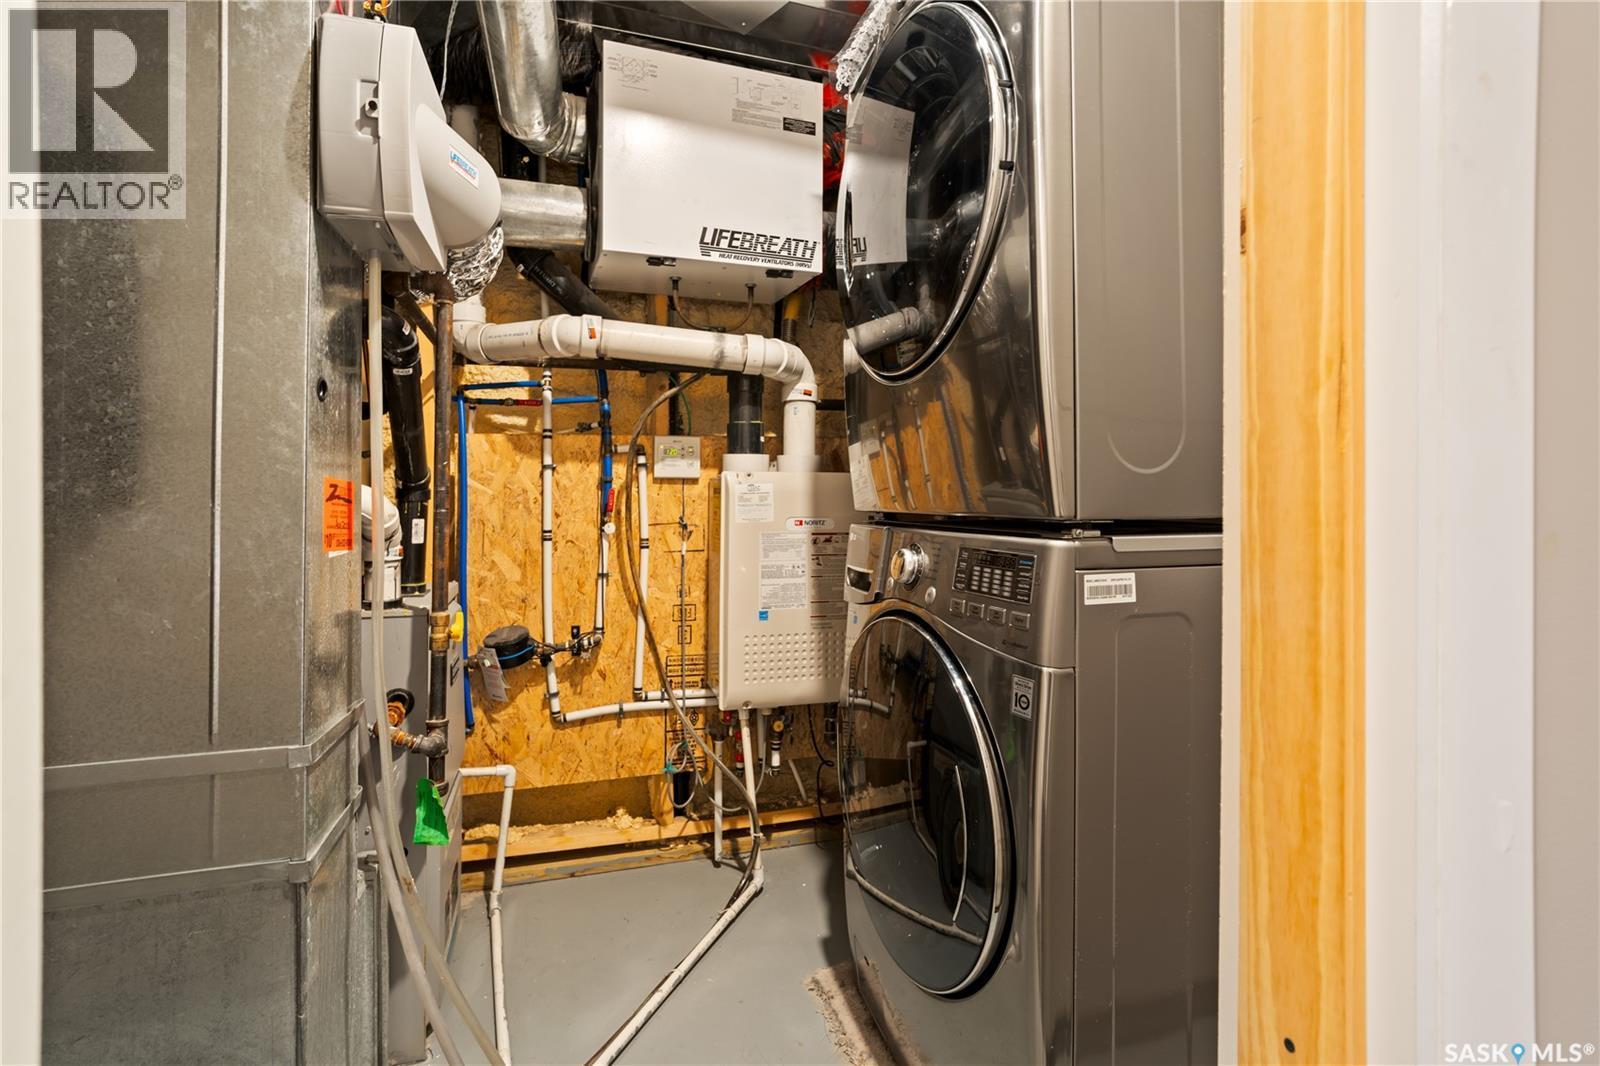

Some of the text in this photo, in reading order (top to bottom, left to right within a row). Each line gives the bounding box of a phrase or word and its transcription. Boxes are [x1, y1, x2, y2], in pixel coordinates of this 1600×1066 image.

[699, 227, 817, 258] LIFEBREATH
[733, 255, 760, 263] RECOVERY
[761, 258, 795, 267] VENTILATORS
